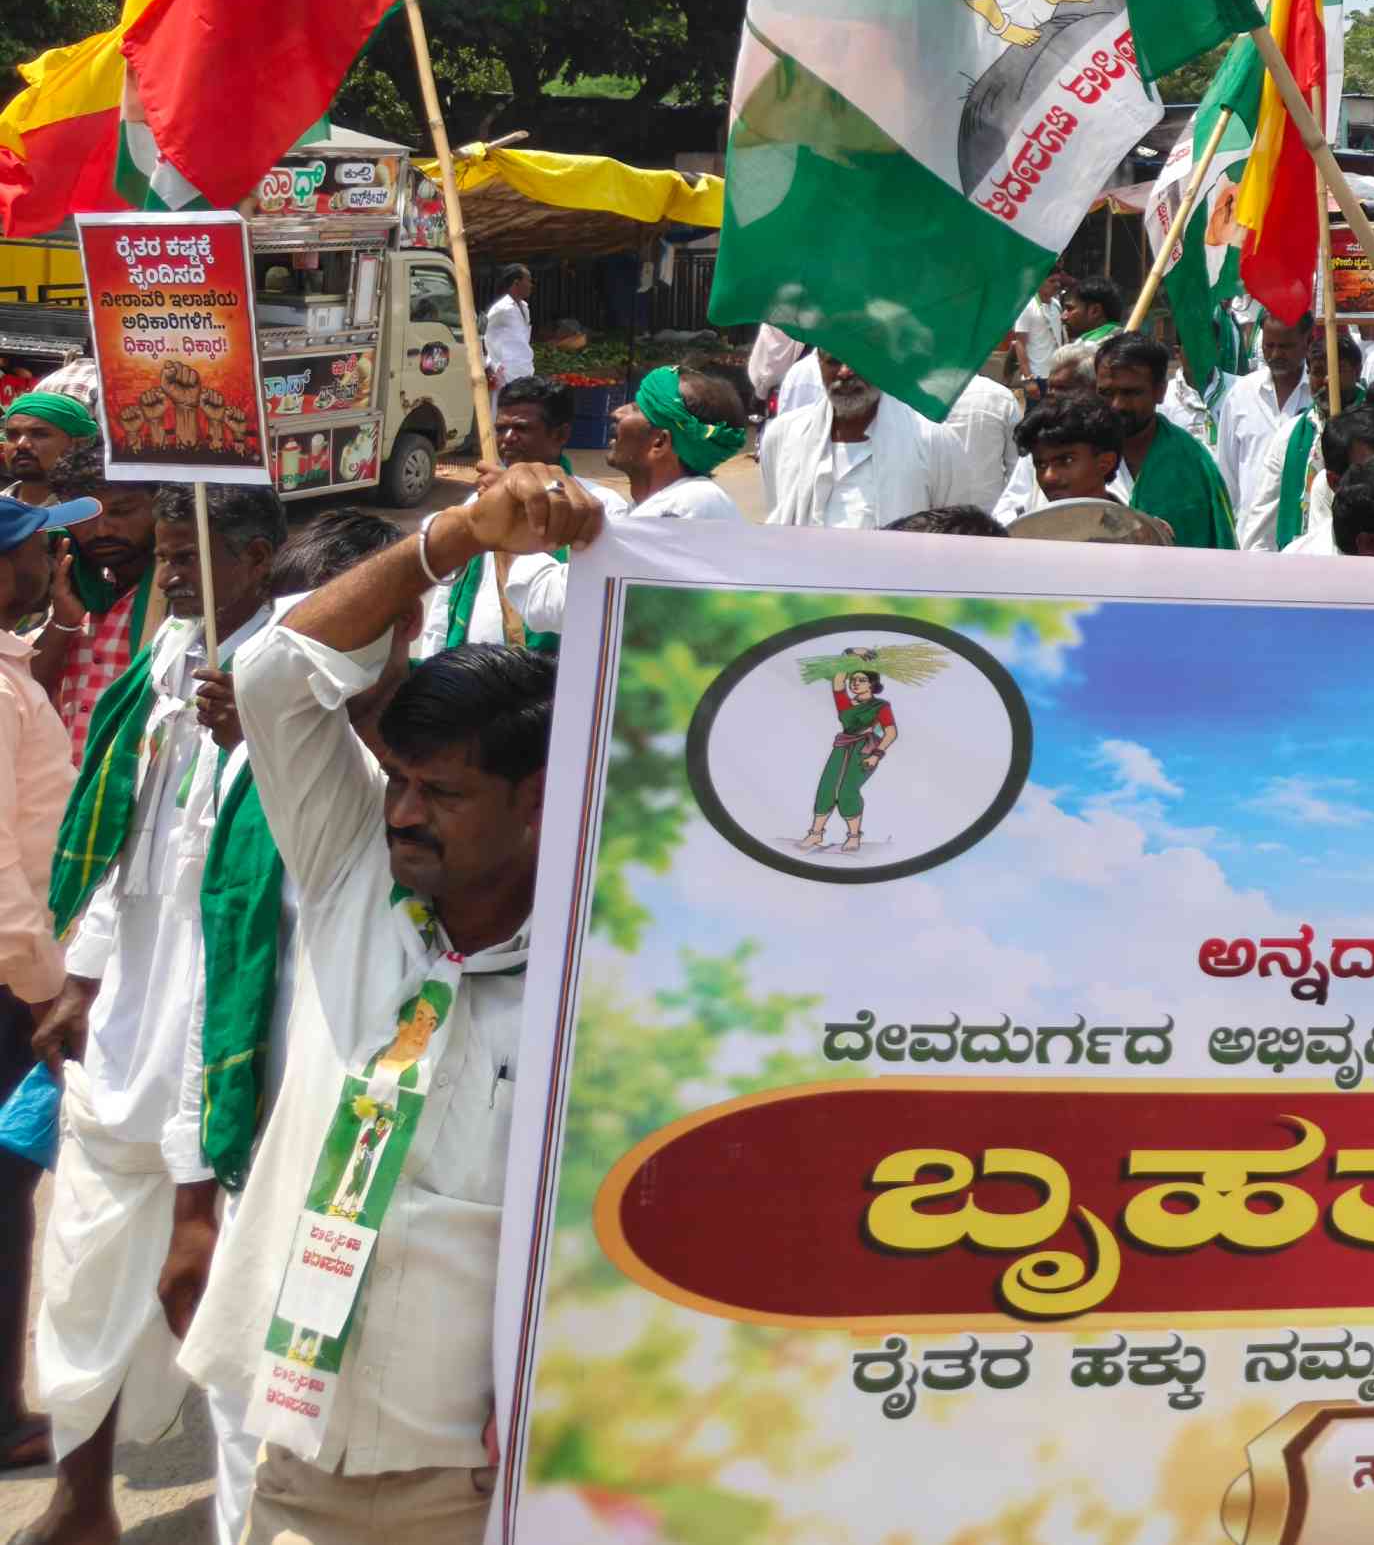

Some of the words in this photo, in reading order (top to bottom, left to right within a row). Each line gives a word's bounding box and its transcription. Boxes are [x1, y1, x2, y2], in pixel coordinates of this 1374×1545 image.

[115, 236, 161, 265] ರೈತರ
[164, 234, 215, 265] ಕಷ್ಟಕ್ಕೆ
[128, 265, 205, 290] ಸ್ಪಂದಿಸದ
[101, 290, 166, 307] ನೀರಾವರಿ
[169, 289, 238, 308] ಇಲಾಖೆಯ
[823, 1010, 1174, 1064] ದೇವದುರ್ಗದ
[852, 1334, 1034, 1420] ರೈತರ
[1071, 1333, 1207, 1411] ಹಕ್ಕು
